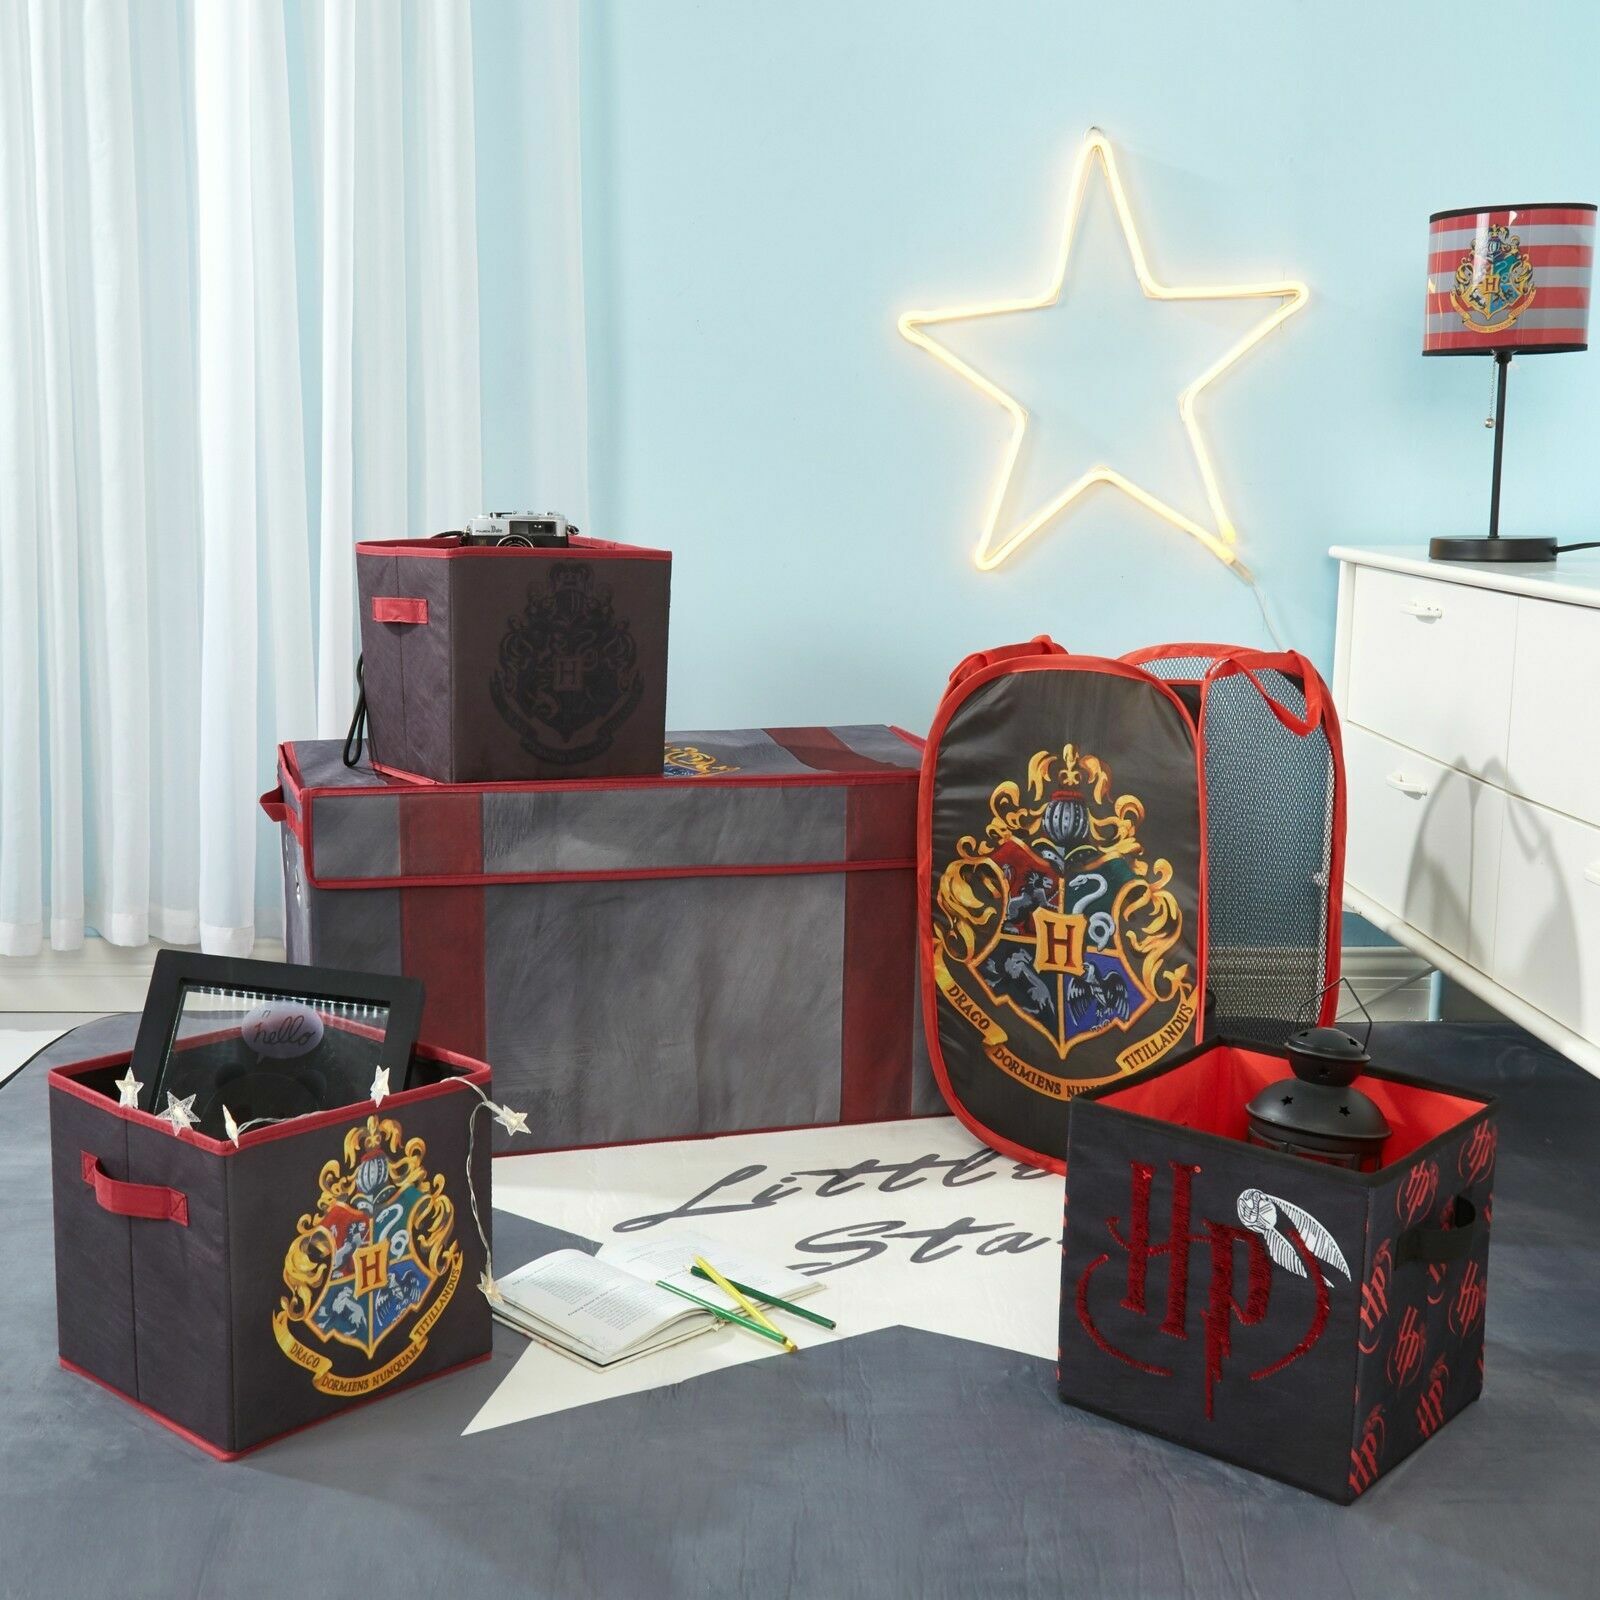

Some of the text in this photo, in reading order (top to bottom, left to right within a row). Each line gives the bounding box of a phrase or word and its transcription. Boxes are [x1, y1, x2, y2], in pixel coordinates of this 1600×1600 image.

[1485, 277, 1496, 292] H
[1045, 920, 1077, 968] H
[993, 1047, 1062, 1095] DORMIENS
[1122, 1003, 1194, 1070] TITILLANDUS
[359, 1250, 383, 1290] H
[785, 1216, 1064, 1277] Sta
[289, 1267, 460, 1393] DRACO DORMIENS NUNQUAM TITILLANDUS
